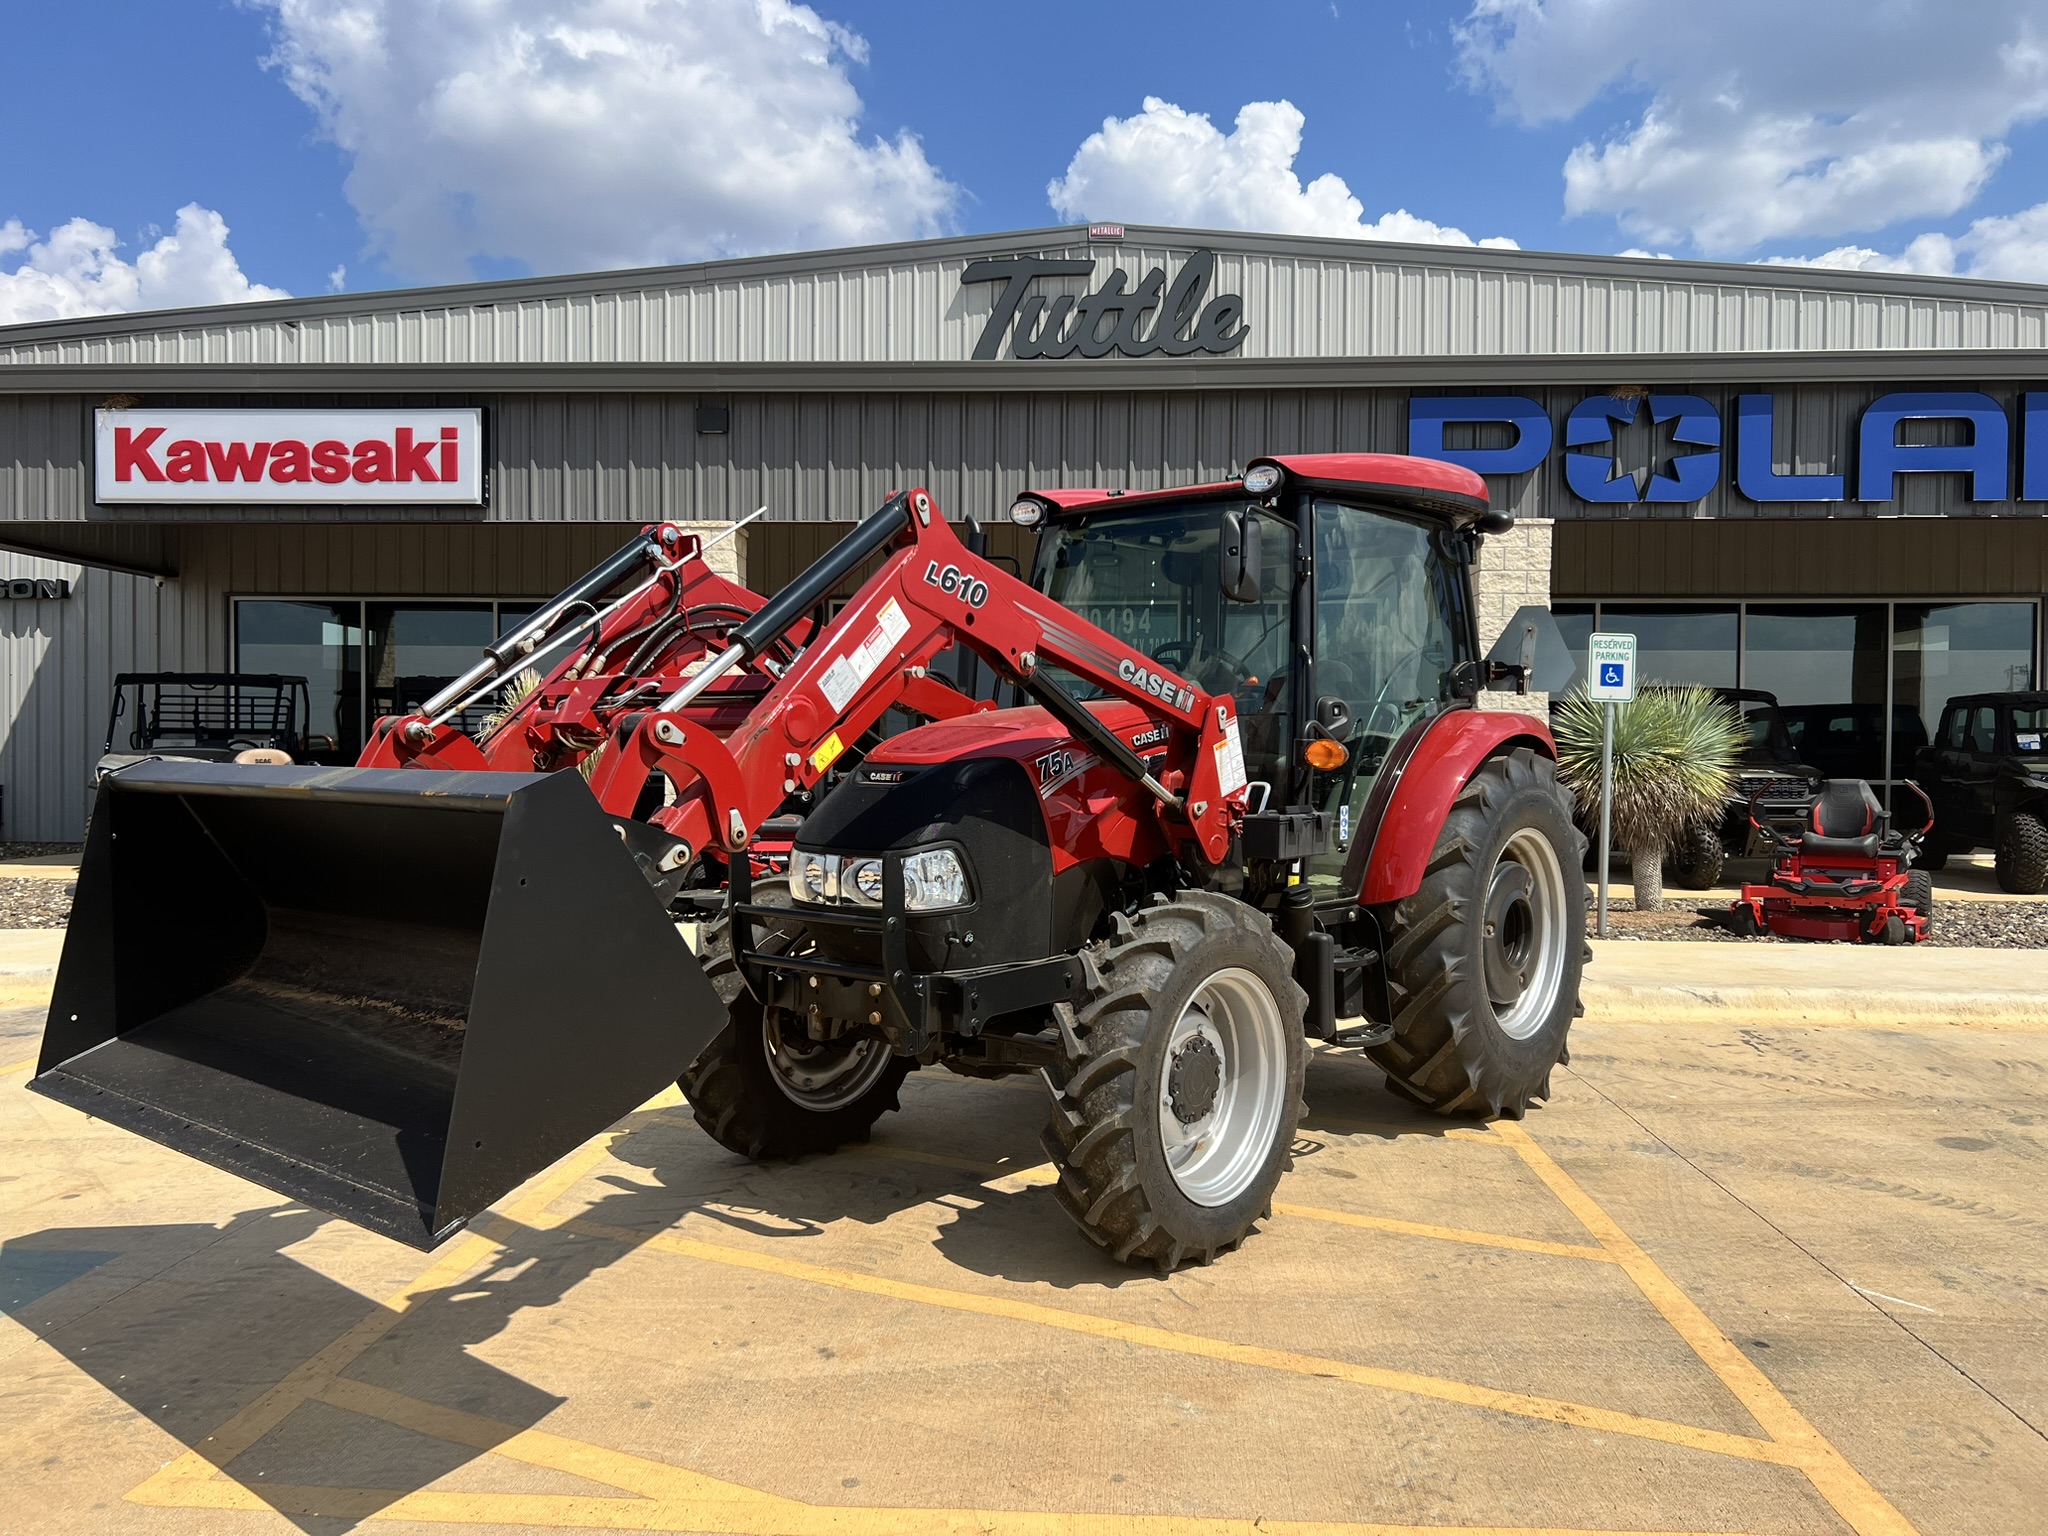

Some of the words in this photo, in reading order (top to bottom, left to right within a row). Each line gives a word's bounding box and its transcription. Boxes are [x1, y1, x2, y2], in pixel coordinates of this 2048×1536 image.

[960, 249, 1251, 360] Tuttle
[114, 427, 459, 483] Kawasaki
[1409, 391, 2048, 502] POLA
[0, 579, 67, 599] ON
[923, 560, 988, 609] L610
[1594, 640, 1632, 649] RESERVED
[1596, 651, 1629, 661] PARKING
[1036, 749, 1075, 782] 75A
